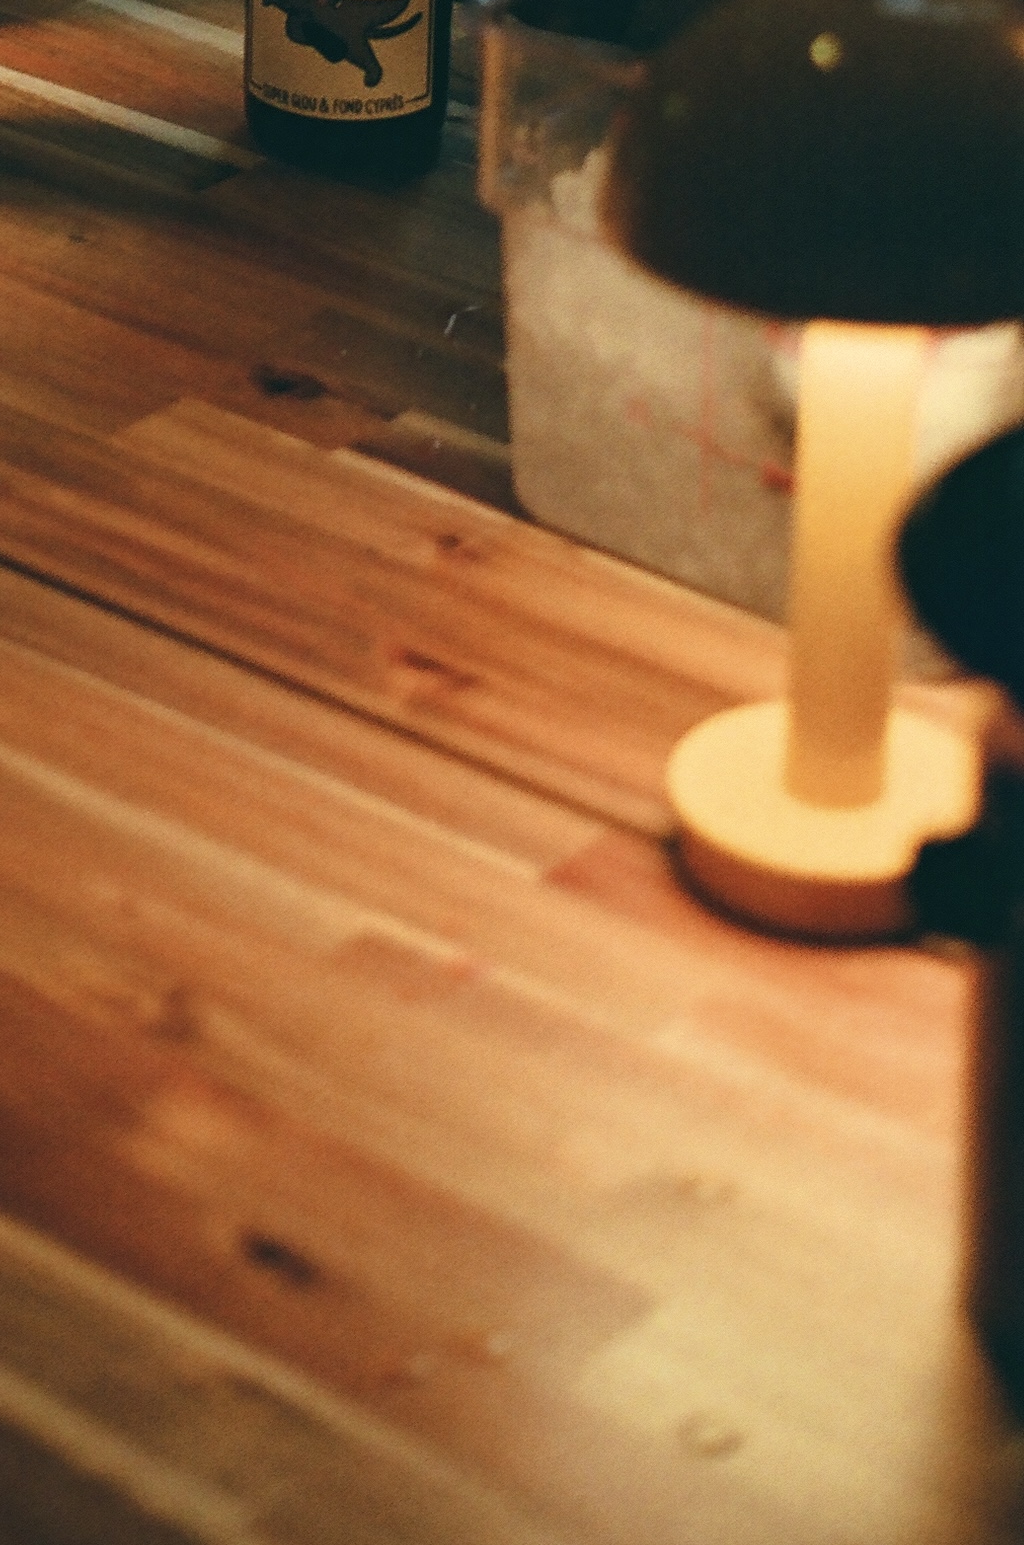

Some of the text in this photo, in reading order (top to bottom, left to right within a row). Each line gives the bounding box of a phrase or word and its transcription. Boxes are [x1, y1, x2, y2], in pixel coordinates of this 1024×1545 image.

[291, 93, 317, 111] GLOU
[319, 96, 329, 113] &
[332, 98, 363, 114] FOND
